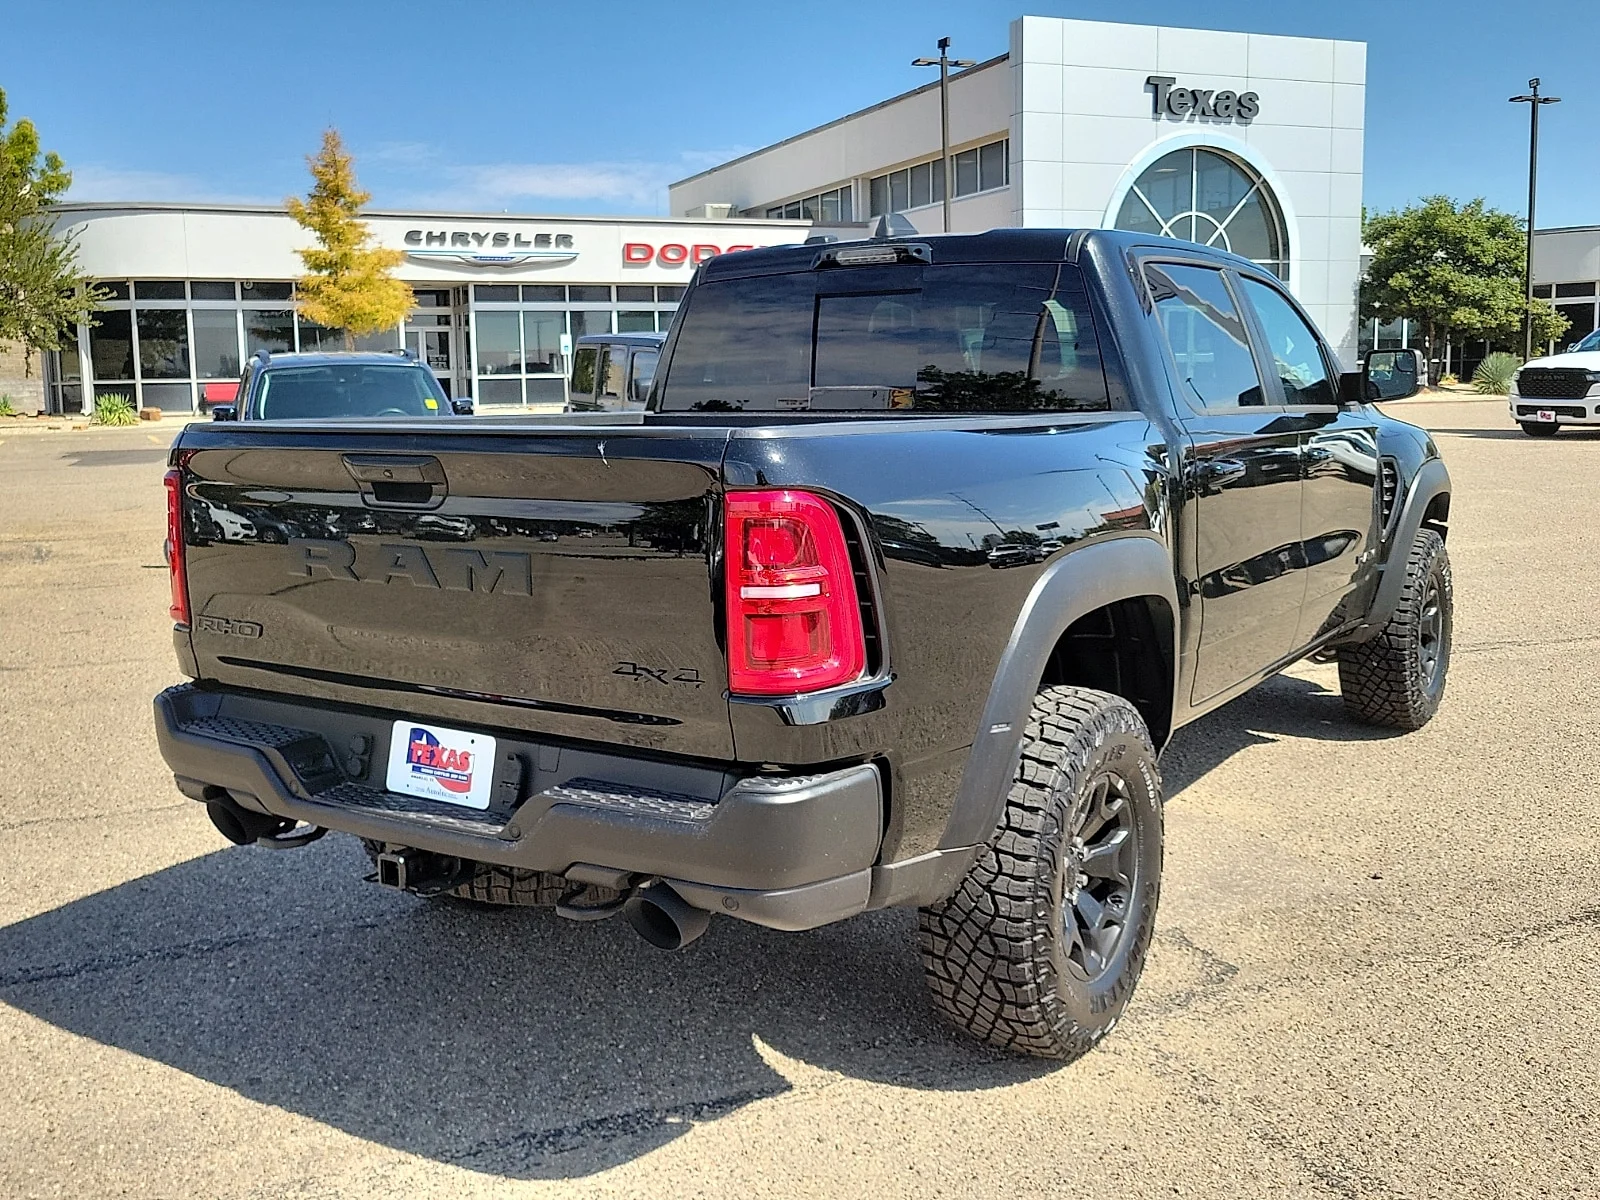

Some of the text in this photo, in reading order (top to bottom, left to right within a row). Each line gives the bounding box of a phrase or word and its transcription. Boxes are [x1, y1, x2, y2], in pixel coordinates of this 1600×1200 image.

[1146, 75, 1260, 119] Texas
[404, 230, 575, 248] CHRYSLER
[623, 243, 767, 264] DOD
[288, 538, 533, 597] RAM
[198, 616, 262, 638] RHO
[410, 741, 471, 772] TEXAS
